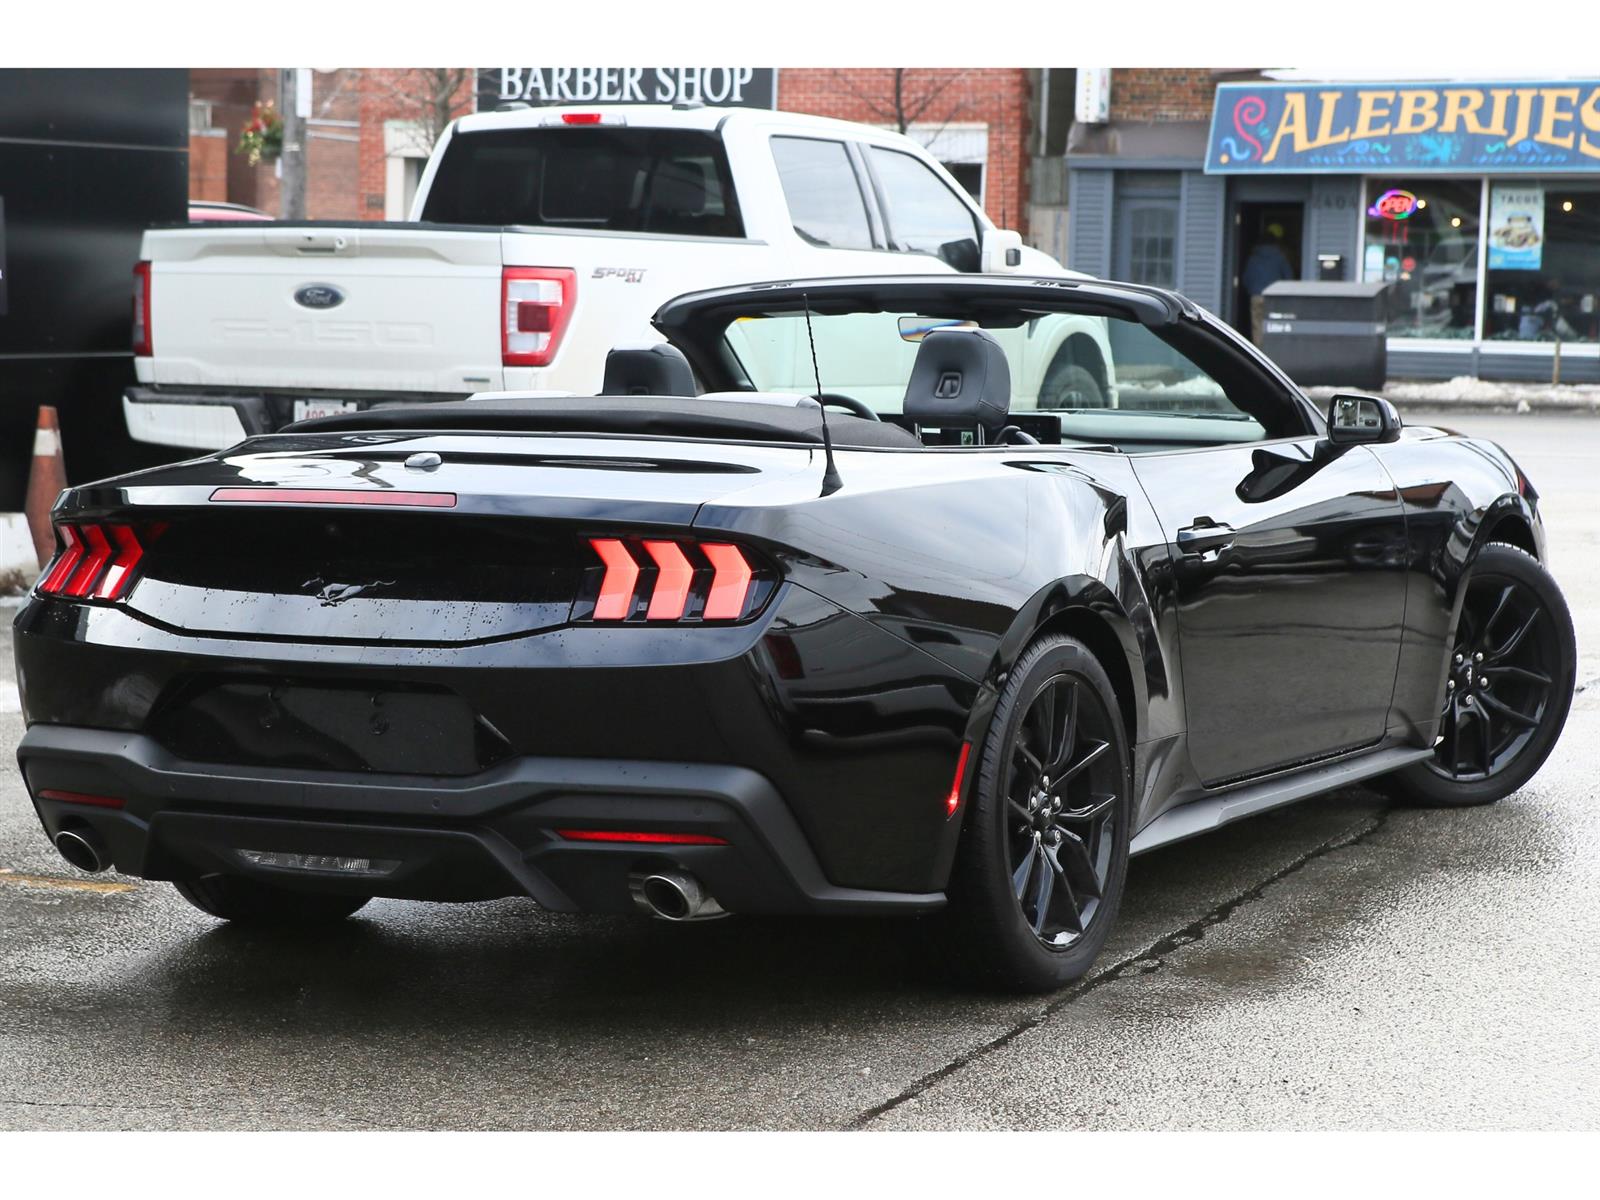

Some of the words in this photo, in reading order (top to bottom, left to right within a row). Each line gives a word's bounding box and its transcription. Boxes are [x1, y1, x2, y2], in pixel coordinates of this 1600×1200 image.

[500, 68, 649, 101] BARBER
[655, 68, 753, 102] SHOP
[1261, 87, 1600, 164] ALEBRIJES
[1380, 195, 1412, 214] OPEN
[591, 267, 648, 283] SPORT
[210, 316, 434, 347] F-150
